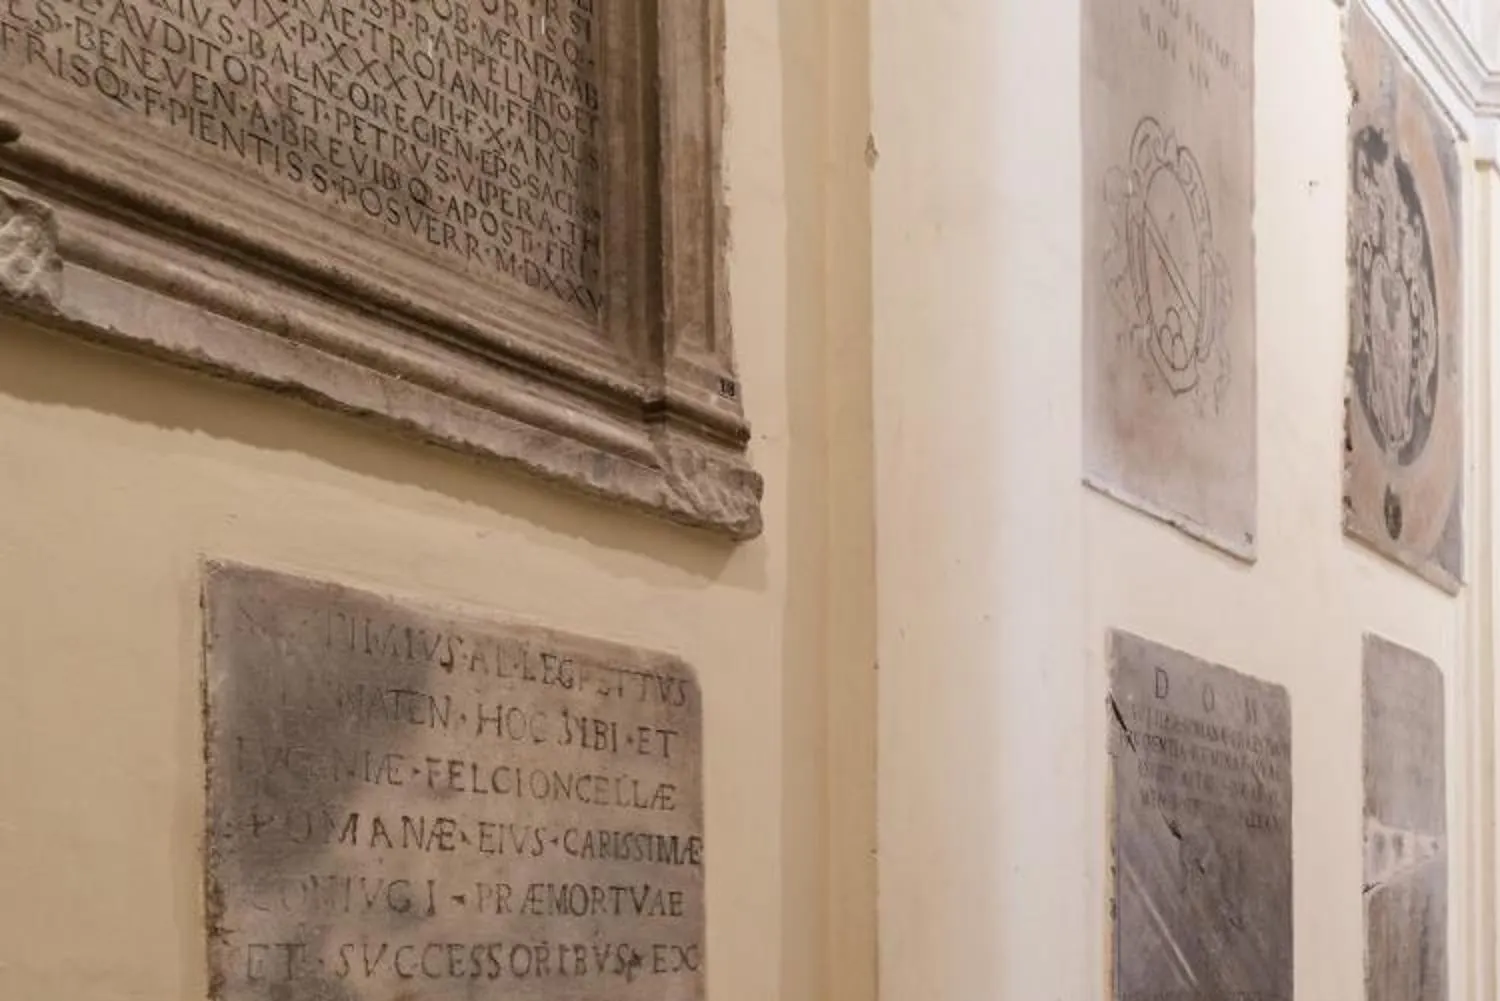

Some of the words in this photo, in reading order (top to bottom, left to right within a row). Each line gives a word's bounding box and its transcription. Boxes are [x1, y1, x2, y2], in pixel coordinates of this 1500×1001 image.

[170, 97, 328, 194] PIENTISS
[341, 175, 484, 270] POSVERR
[287, 82, 327, 124] ET
[335, 107, 449, 184] PETRVS
[455, 167, 555, 237] VIPERA
[475, 703, 547, 746] HOC
[638, 725, 679, 759] ET
[478, 820, 547, 858] EIVS
[652, 943, 700, 975] EX
